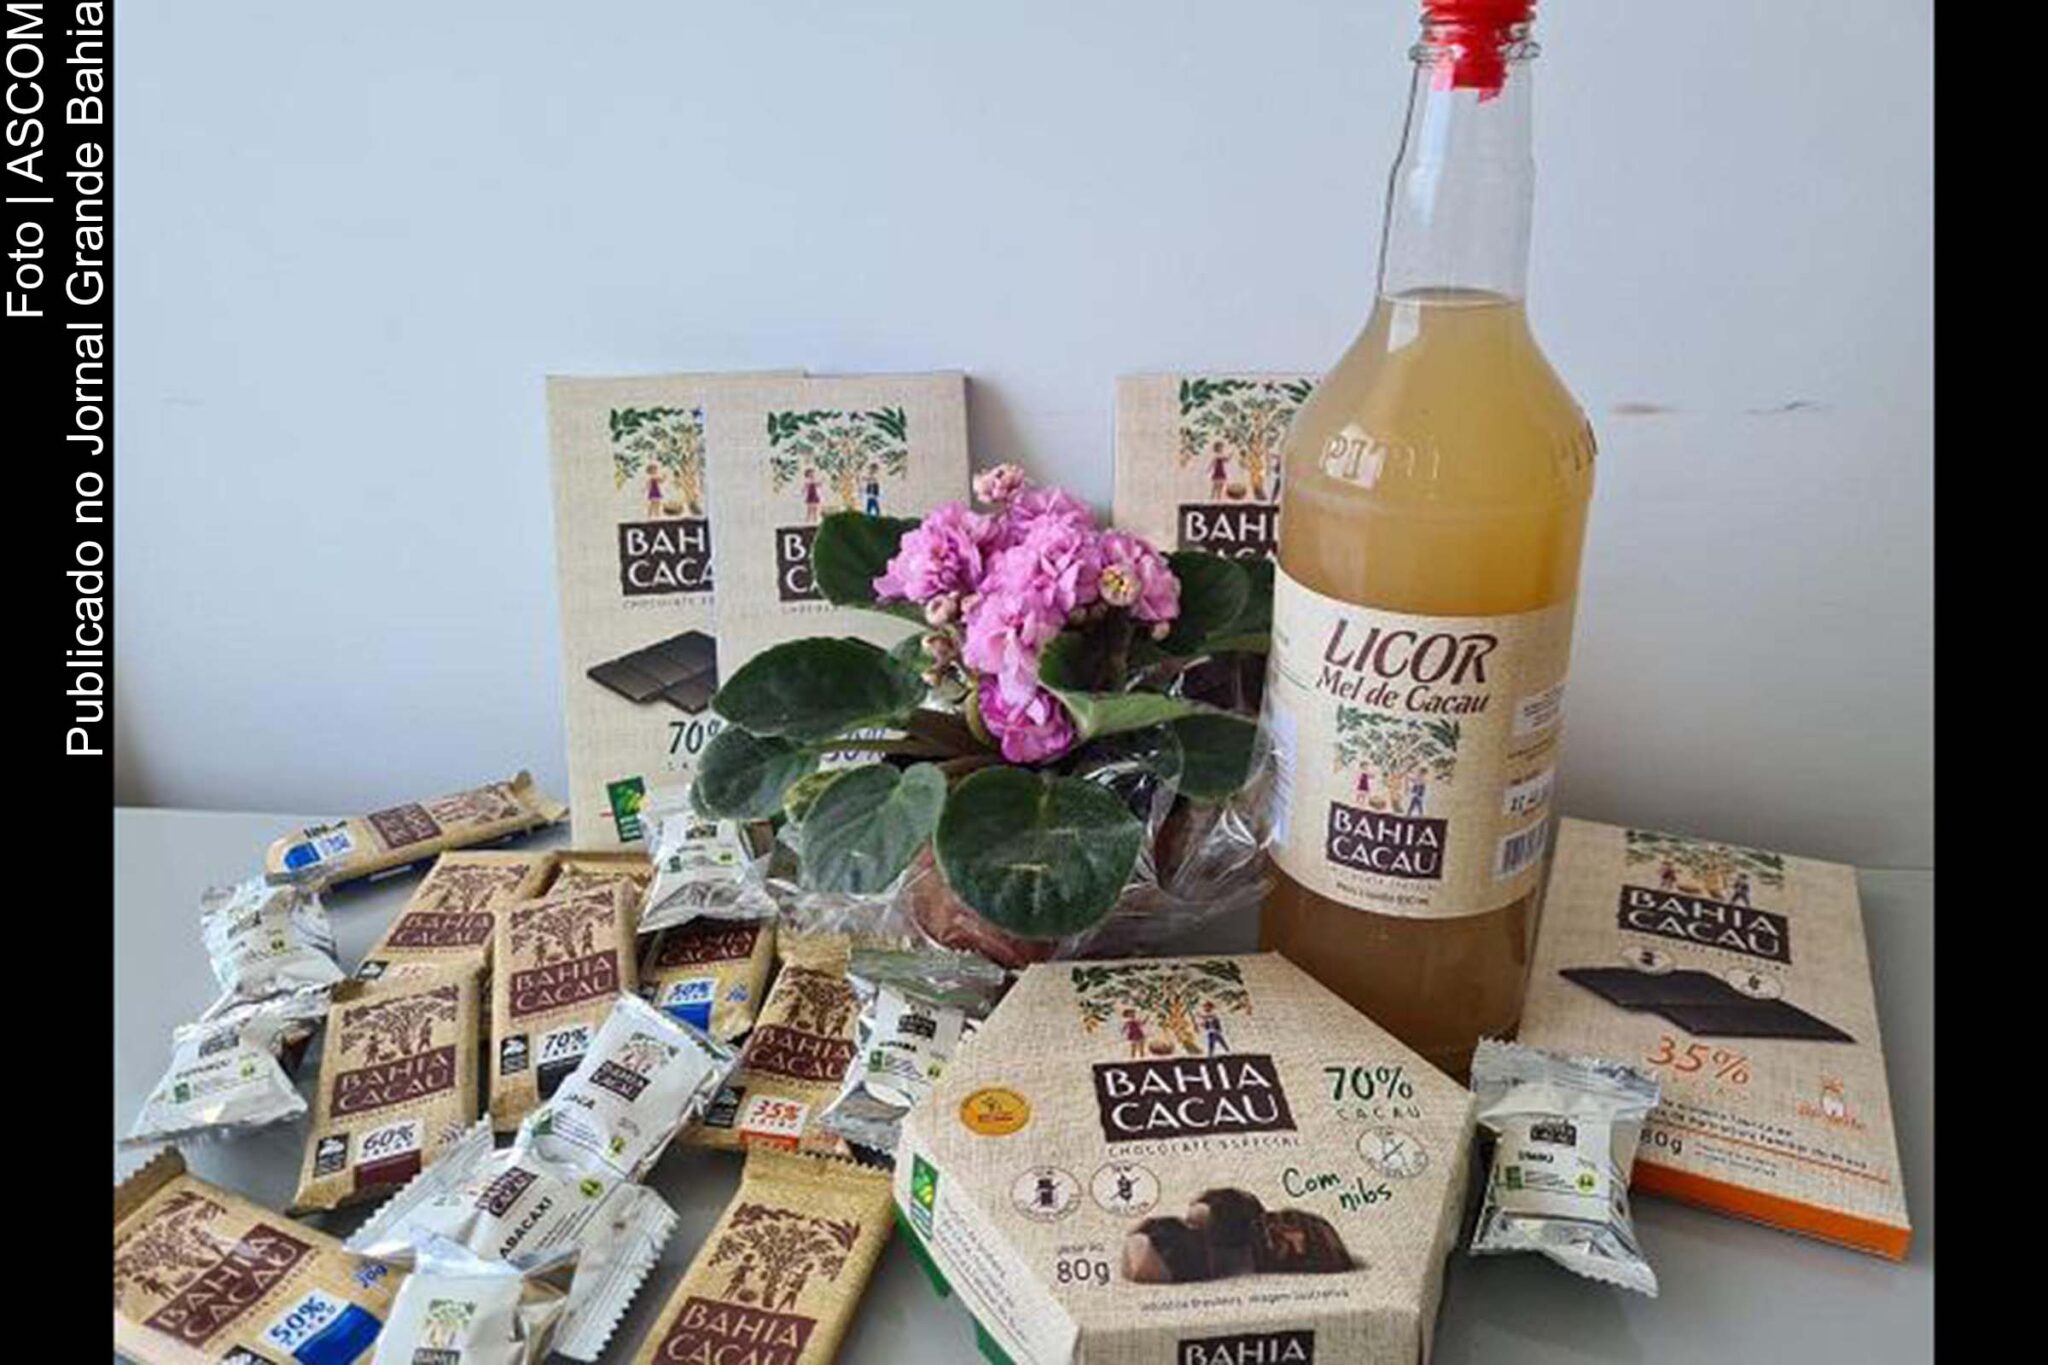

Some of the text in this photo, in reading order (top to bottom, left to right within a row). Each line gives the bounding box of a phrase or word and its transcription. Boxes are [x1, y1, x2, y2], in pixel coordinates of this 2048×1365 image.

[627, 527, 705, 556] BAH
[1186, 511, 1280, 541] BAHI
[628, 558, 713, 587] CACA
[1324, 618, 1498, 685] LICOR
[1316, 666, 1364, 700] Mel
[1365, 682, 1399, 709] de
[1405, 685, 1490, 714] Cacau
[1334, 808, 1438, 849] BAHIA
[1332, 835, 1438, 875] CACAU
[1630, 889, 1780, 937] BAHIA
[1628, 910, 1779, 956] CACAU
[516, 956, 613, 992] BAHIA
[516, 973, 613, 1012] CACAU
[546, 1025, 588, 1051] 70%
[756, 1028, 851, 1059] BAHIA
[342, 1053, 449, 1093] BAHIA
[750, 1047, 843, 1079] CACAU
[1646, 1035, 1749, 1084] 35%
[339, 1069, 449, 1110] CACAU
[1104, 1061, 1272, 1099] BAHIA
[1324, 1066, 1413, 1101] 70%
[1111, 1093, 1280, 1134] CACAU
[1336, 1106, 1420, 1121] CACAU
[363, 1122, 416, 1150] 60%
[1640, 1129, 1682, 1154] 80g
[1282, 1167, 1341, 1198] Com
[1339, 1177, 1392, 1211] nibs
[499, 1196, 553, 1260] ABACAXI
[158, 1236, 279, 1328] BAHIA
[183, 1243, 299, 1339] CACAU
[1056, 1258, 1110, 1286] 80g
[271, 1296, 326, 1343] 50%
[682, 1303, 798, 1348] BAHIA
[1185, 1338, 1307, 1365] BAHIA
